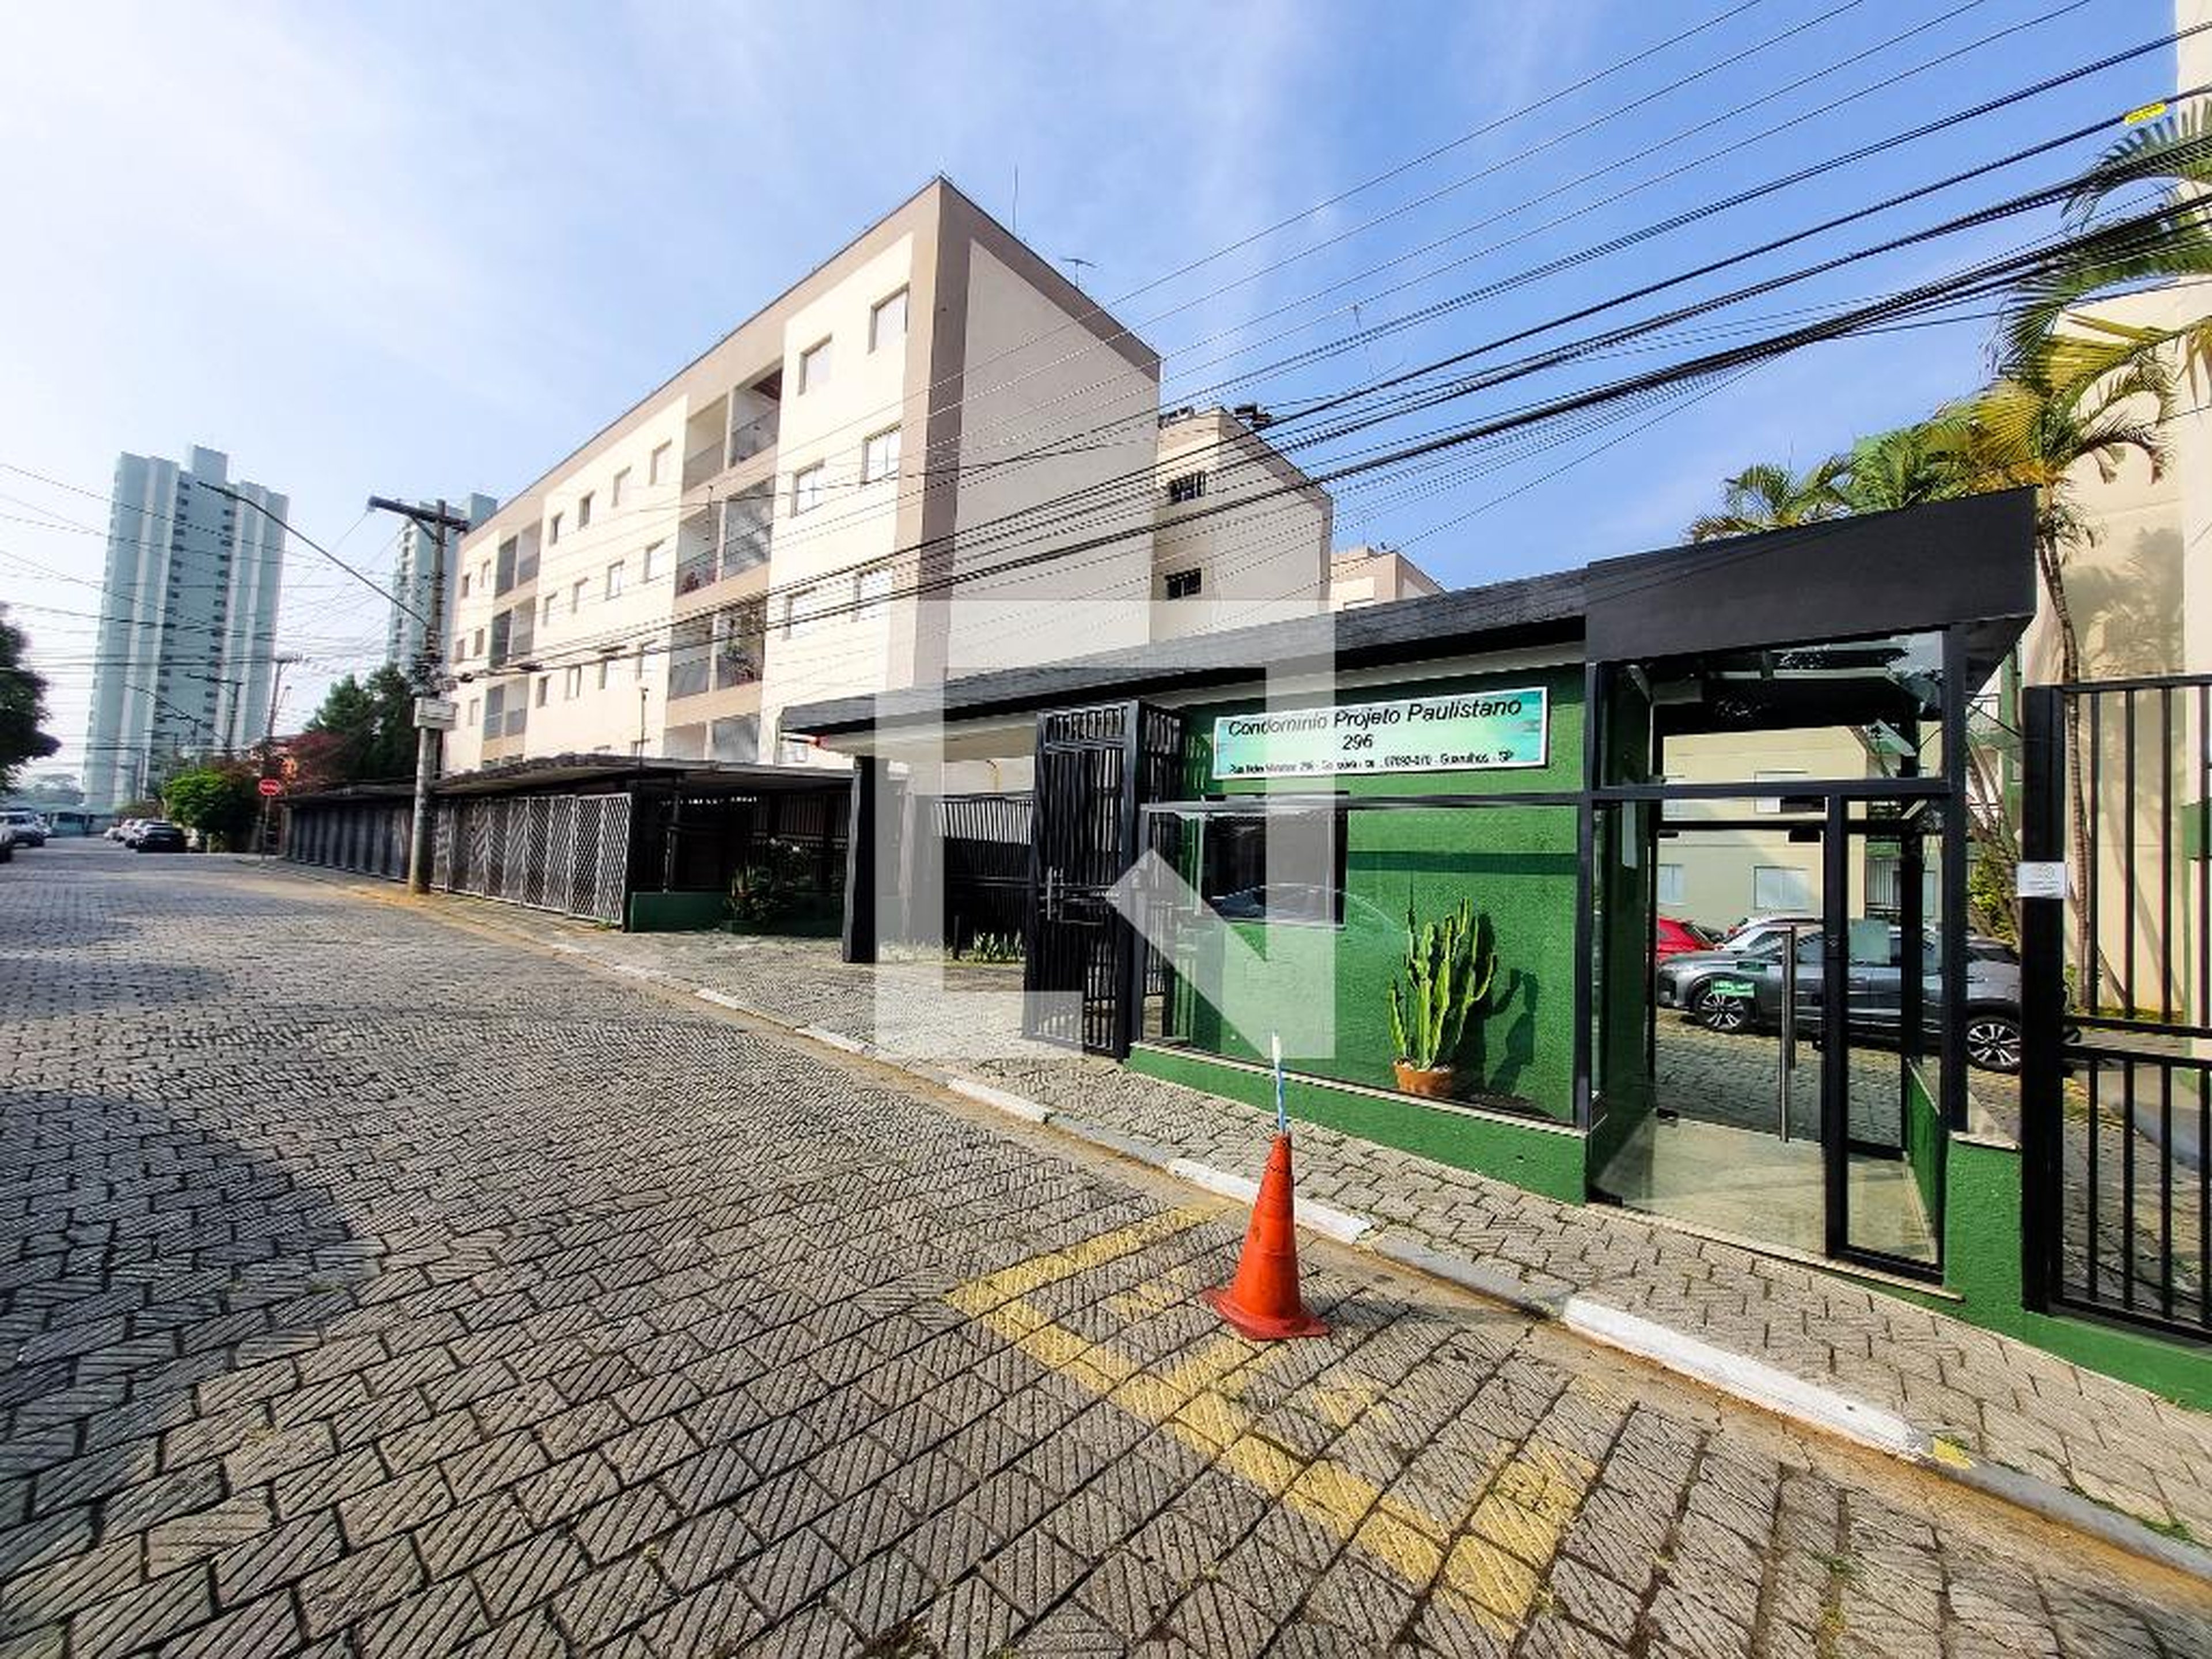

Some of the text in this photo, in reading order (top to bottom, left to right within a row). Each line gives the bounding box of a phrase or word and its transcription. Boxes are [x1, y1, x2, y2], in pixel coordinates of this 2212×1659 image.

[1334, 708, 1400, 730] Projeto
[1407, 699, 1522, 722] Paulistano
[1343, 734, 1373, 750] 296
